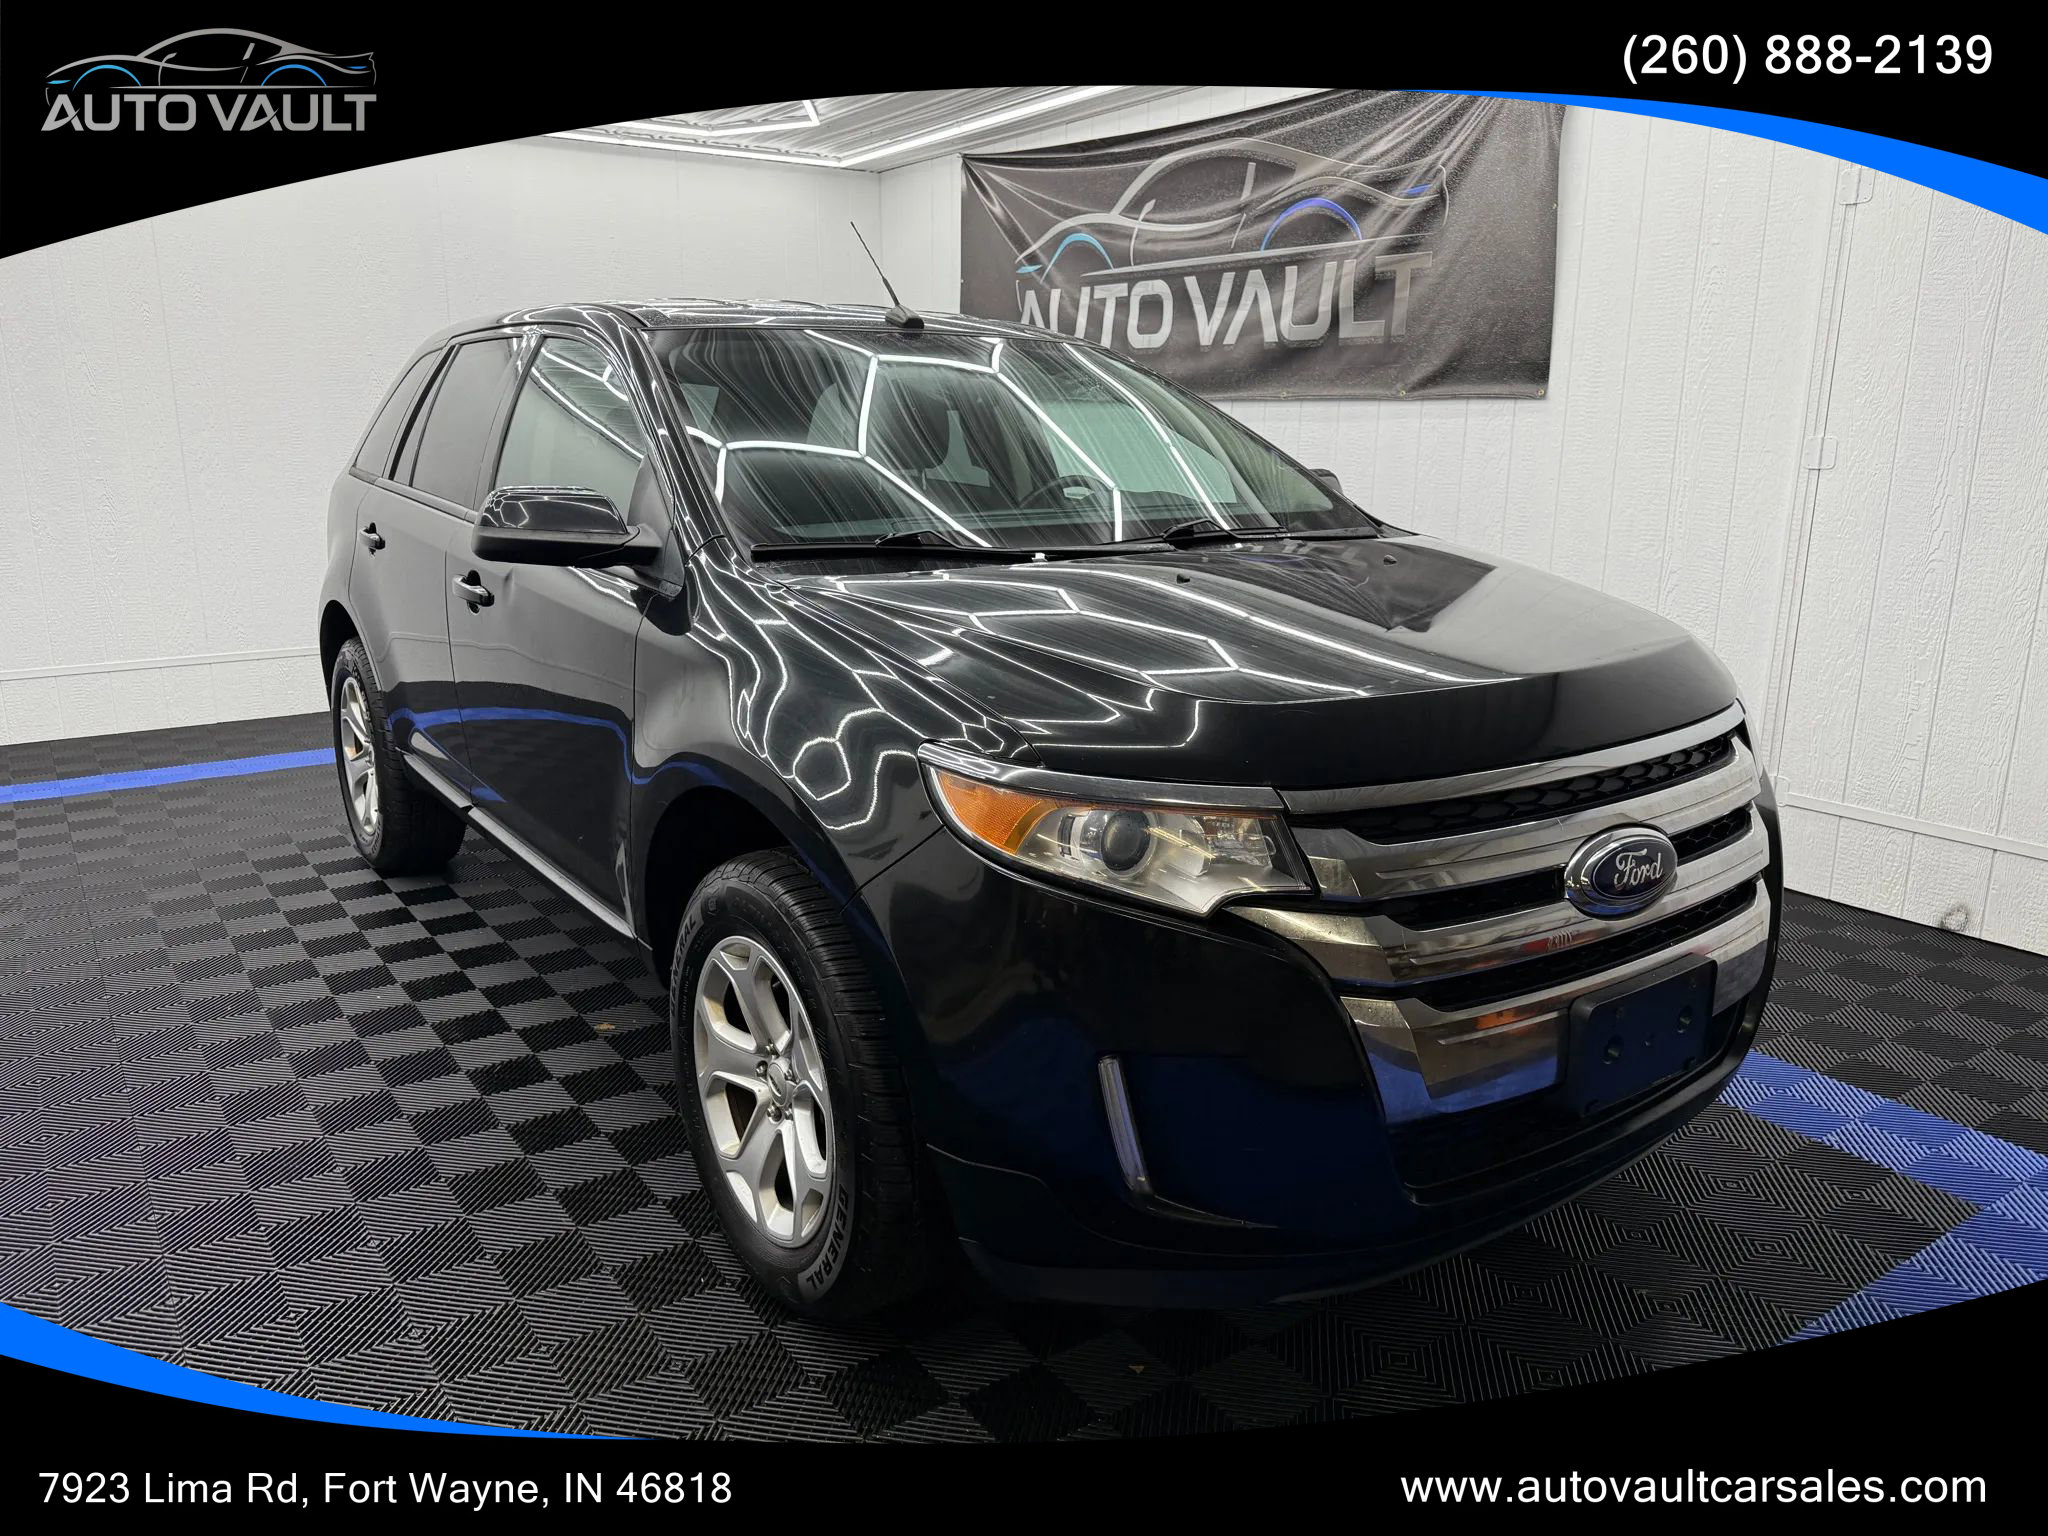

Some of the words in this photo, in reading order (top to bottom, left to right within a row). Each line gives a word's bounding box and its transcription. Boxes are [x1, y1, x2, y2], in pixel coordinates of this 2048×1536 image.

[1185, 251, 1432, 346] VAULT
[1613, 848, 1663, 890] Ford
[806, 1184, 849, 1291] GENERAL
